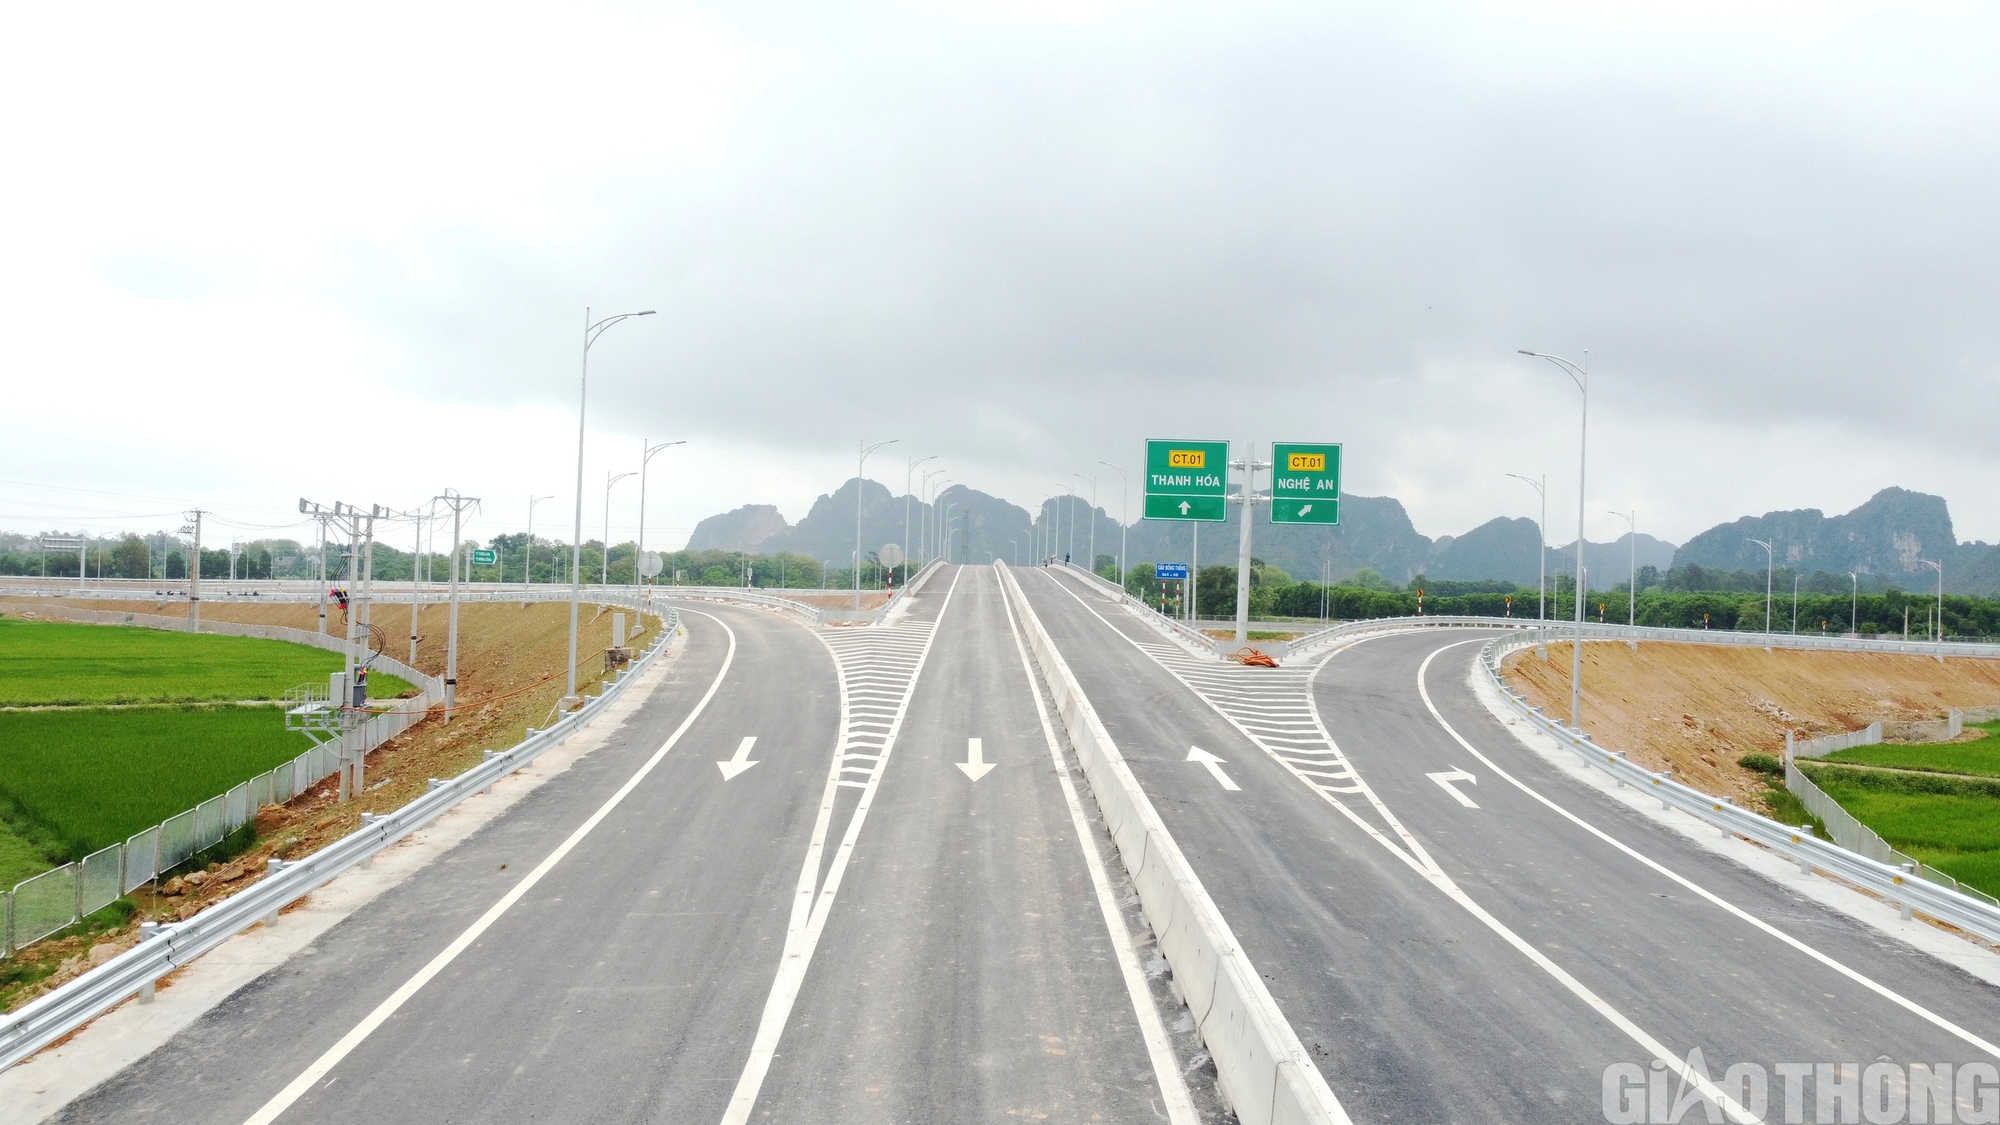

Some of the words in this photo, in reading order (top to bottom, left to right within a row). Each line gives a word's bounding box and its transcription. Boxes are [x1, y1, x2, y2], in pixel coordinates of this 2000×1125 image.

[1172, 453, 1201, 465] CT.01
[1292, 456, 1321, 468] CT.01
[1151, 474, 1191, 486] THANH
[1195, 473, 1220, 487] HÓA
[1278, 476, 1310, 492] NGHỆ
[1316, 479, 1334, 490] AN
